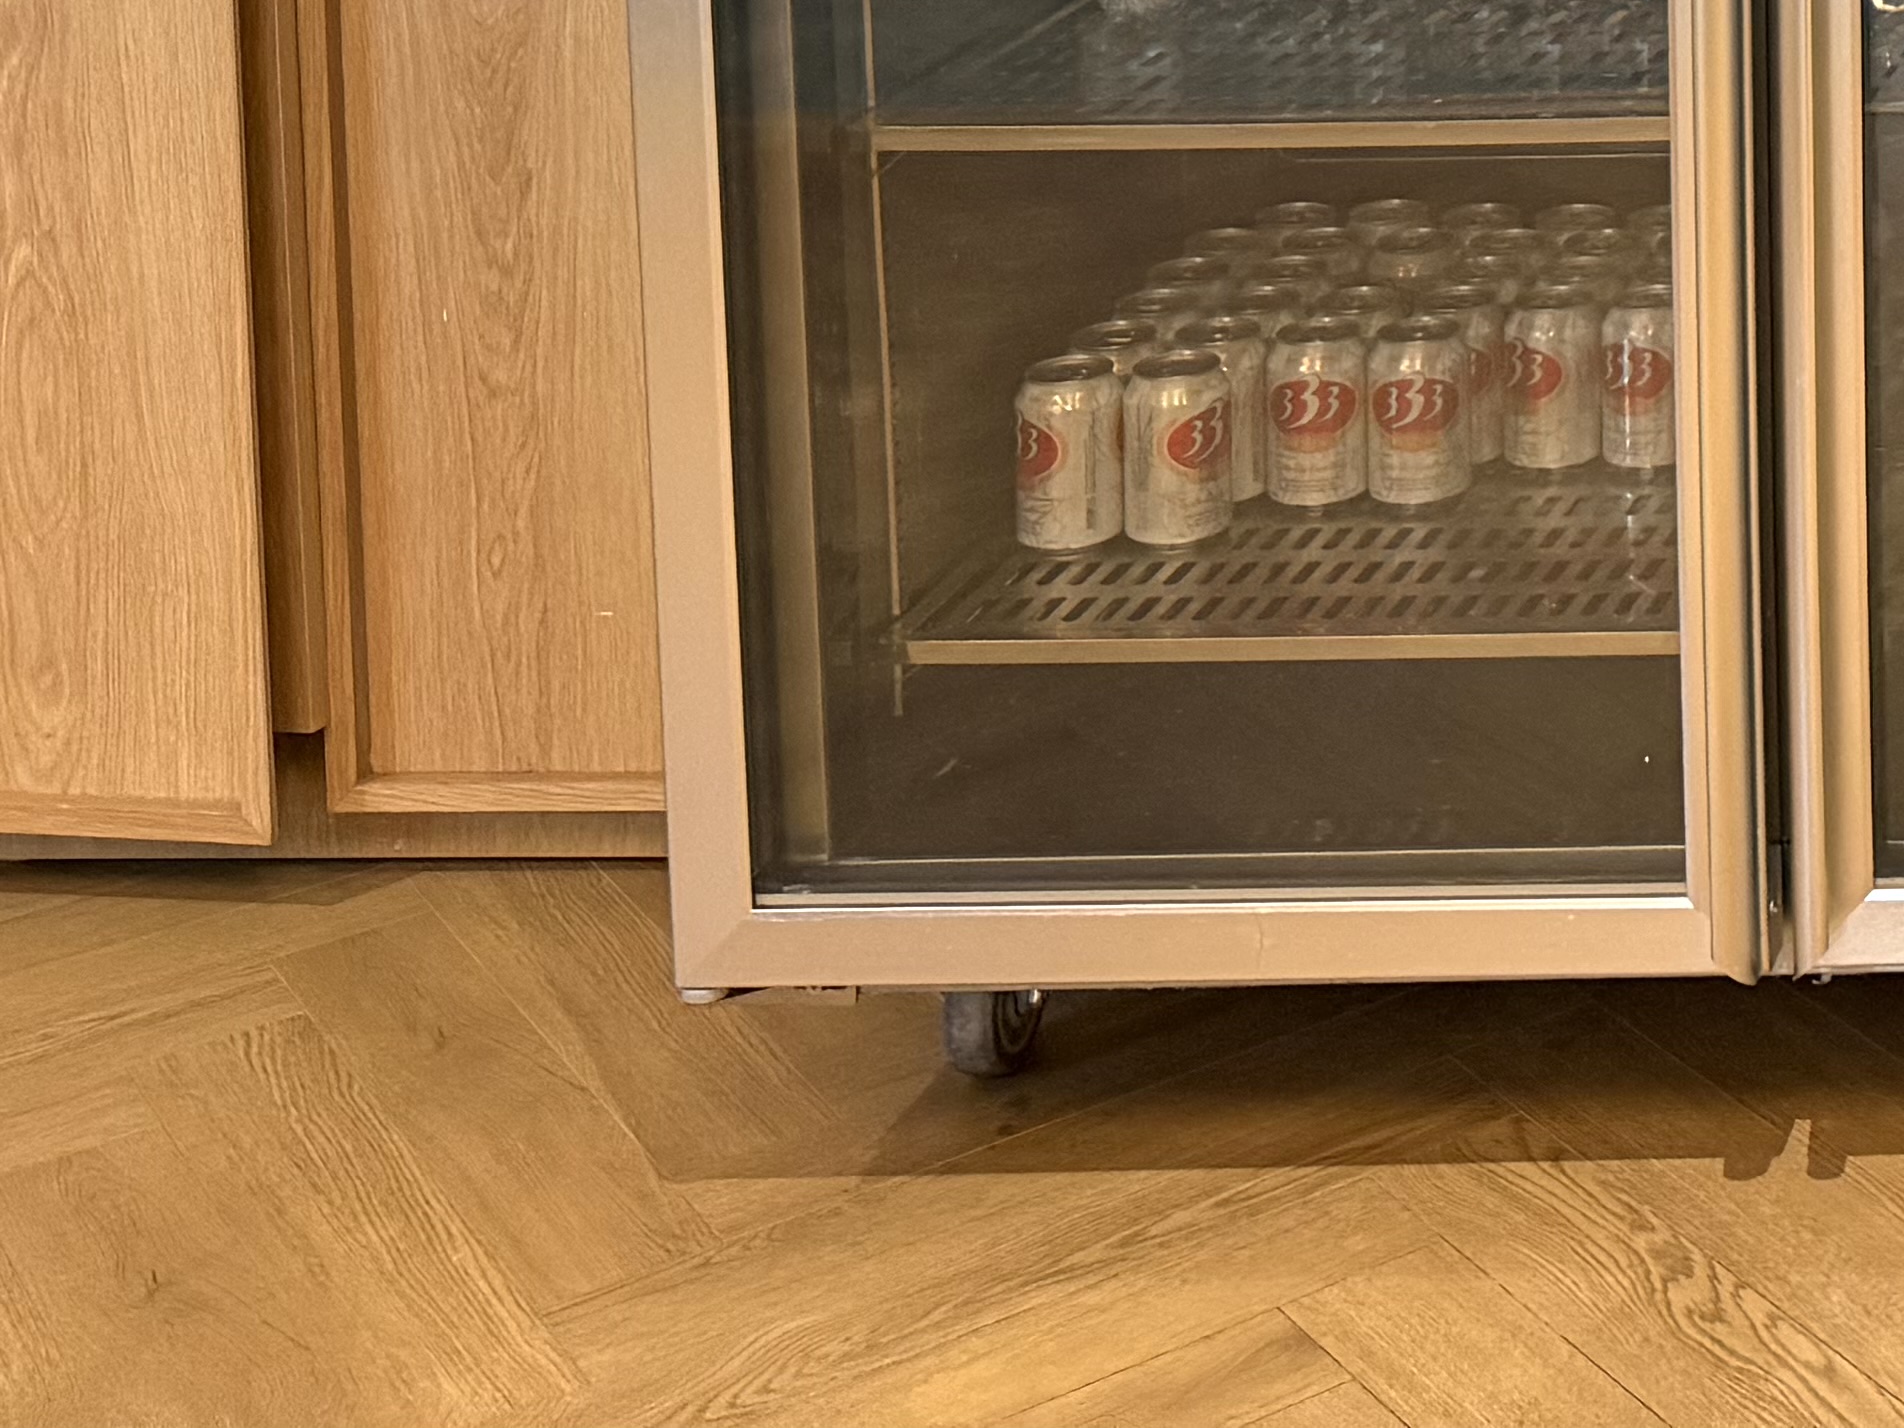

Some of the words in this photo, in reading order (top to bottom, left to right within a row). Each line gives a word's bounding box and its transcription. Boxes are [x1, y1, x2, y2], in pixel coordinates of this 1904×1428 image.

[1507, 338, 1544, 388] 33
[1278, 374, 1341, 428] 333
[1383, 373, 1445, 428] 333
[1183, 396, 1226, 463] 33
